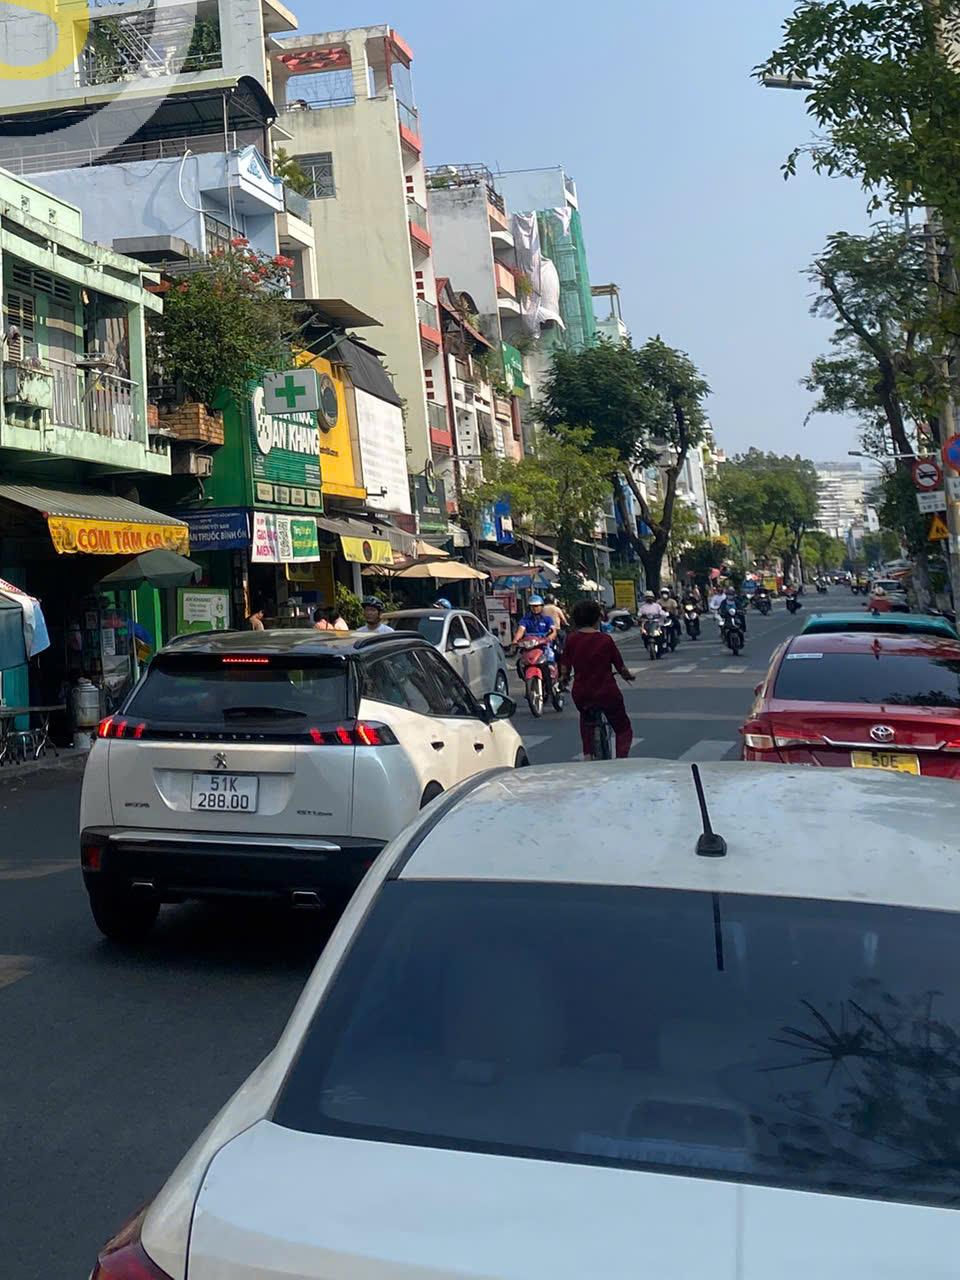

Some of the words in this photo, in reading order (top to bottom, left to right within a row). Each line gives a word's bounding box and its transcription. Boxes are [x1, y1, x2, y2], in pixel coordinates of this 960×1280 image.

[288, 424, 320, 456] KHANG
[78, 528, 112, 549] CƠM
[113, 524, 142, 550] TẤM
[210, 776, 238, 792] 51K
[198, 793, 249, 810] 288.00
